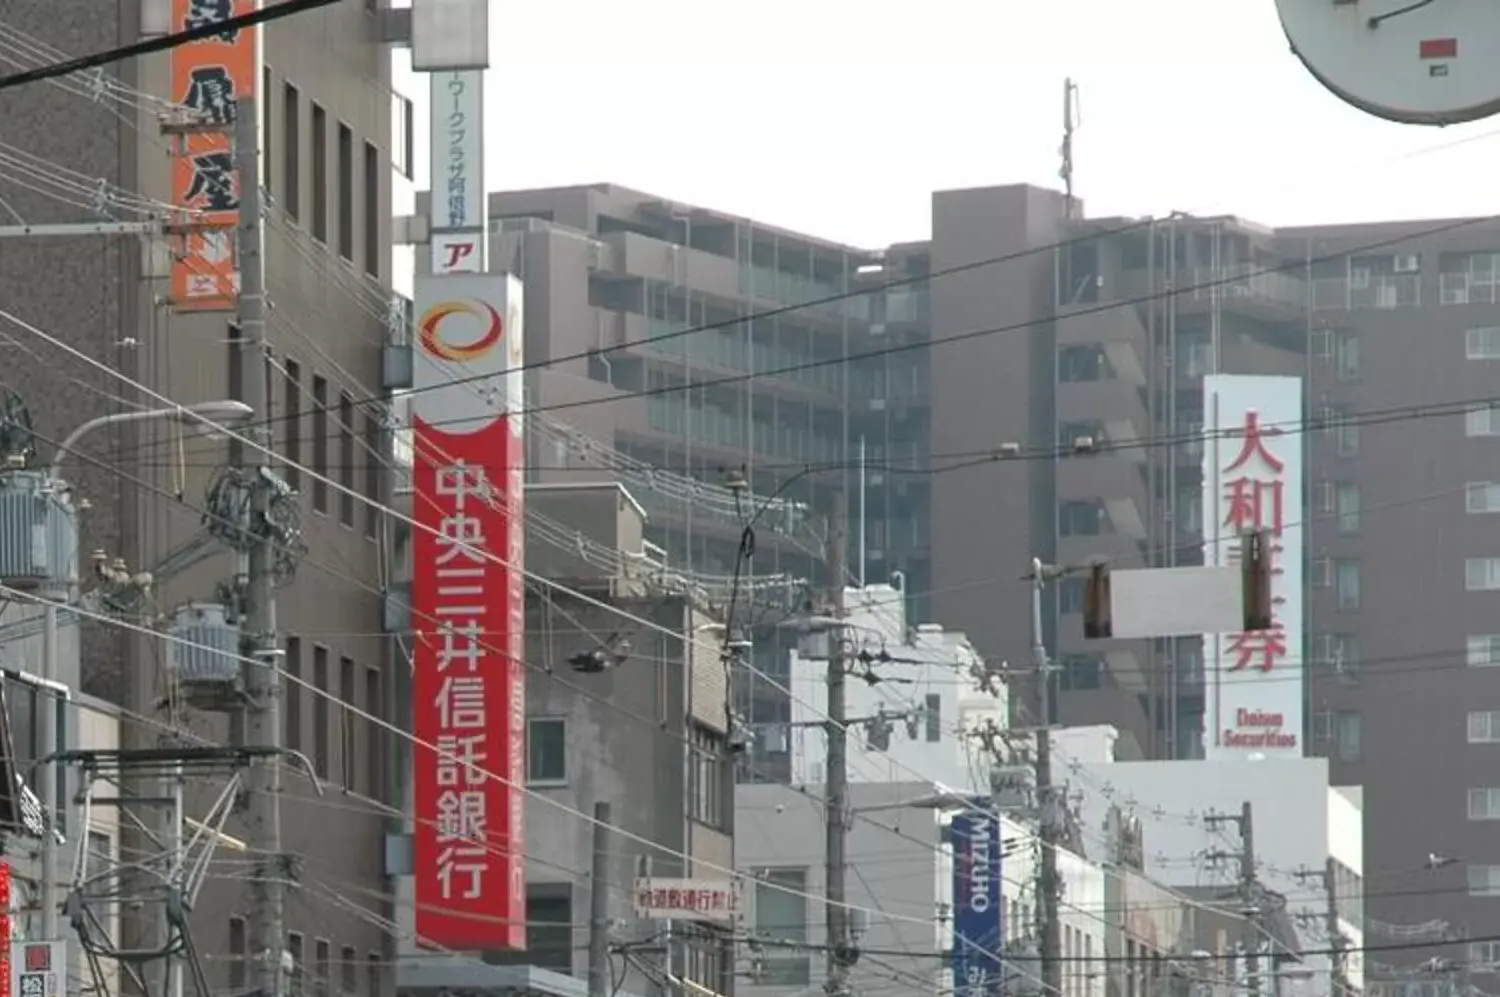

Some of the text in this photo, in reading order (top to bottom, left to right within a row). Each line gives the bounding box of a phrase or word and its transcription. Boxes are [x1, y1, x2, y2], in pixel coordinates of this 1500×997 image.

[1222, 411, 1286, 672] 大和券
[434, 457, 489, 899] 中央三井信託銀行
[969, 818, 991, 914] MIZUHO
